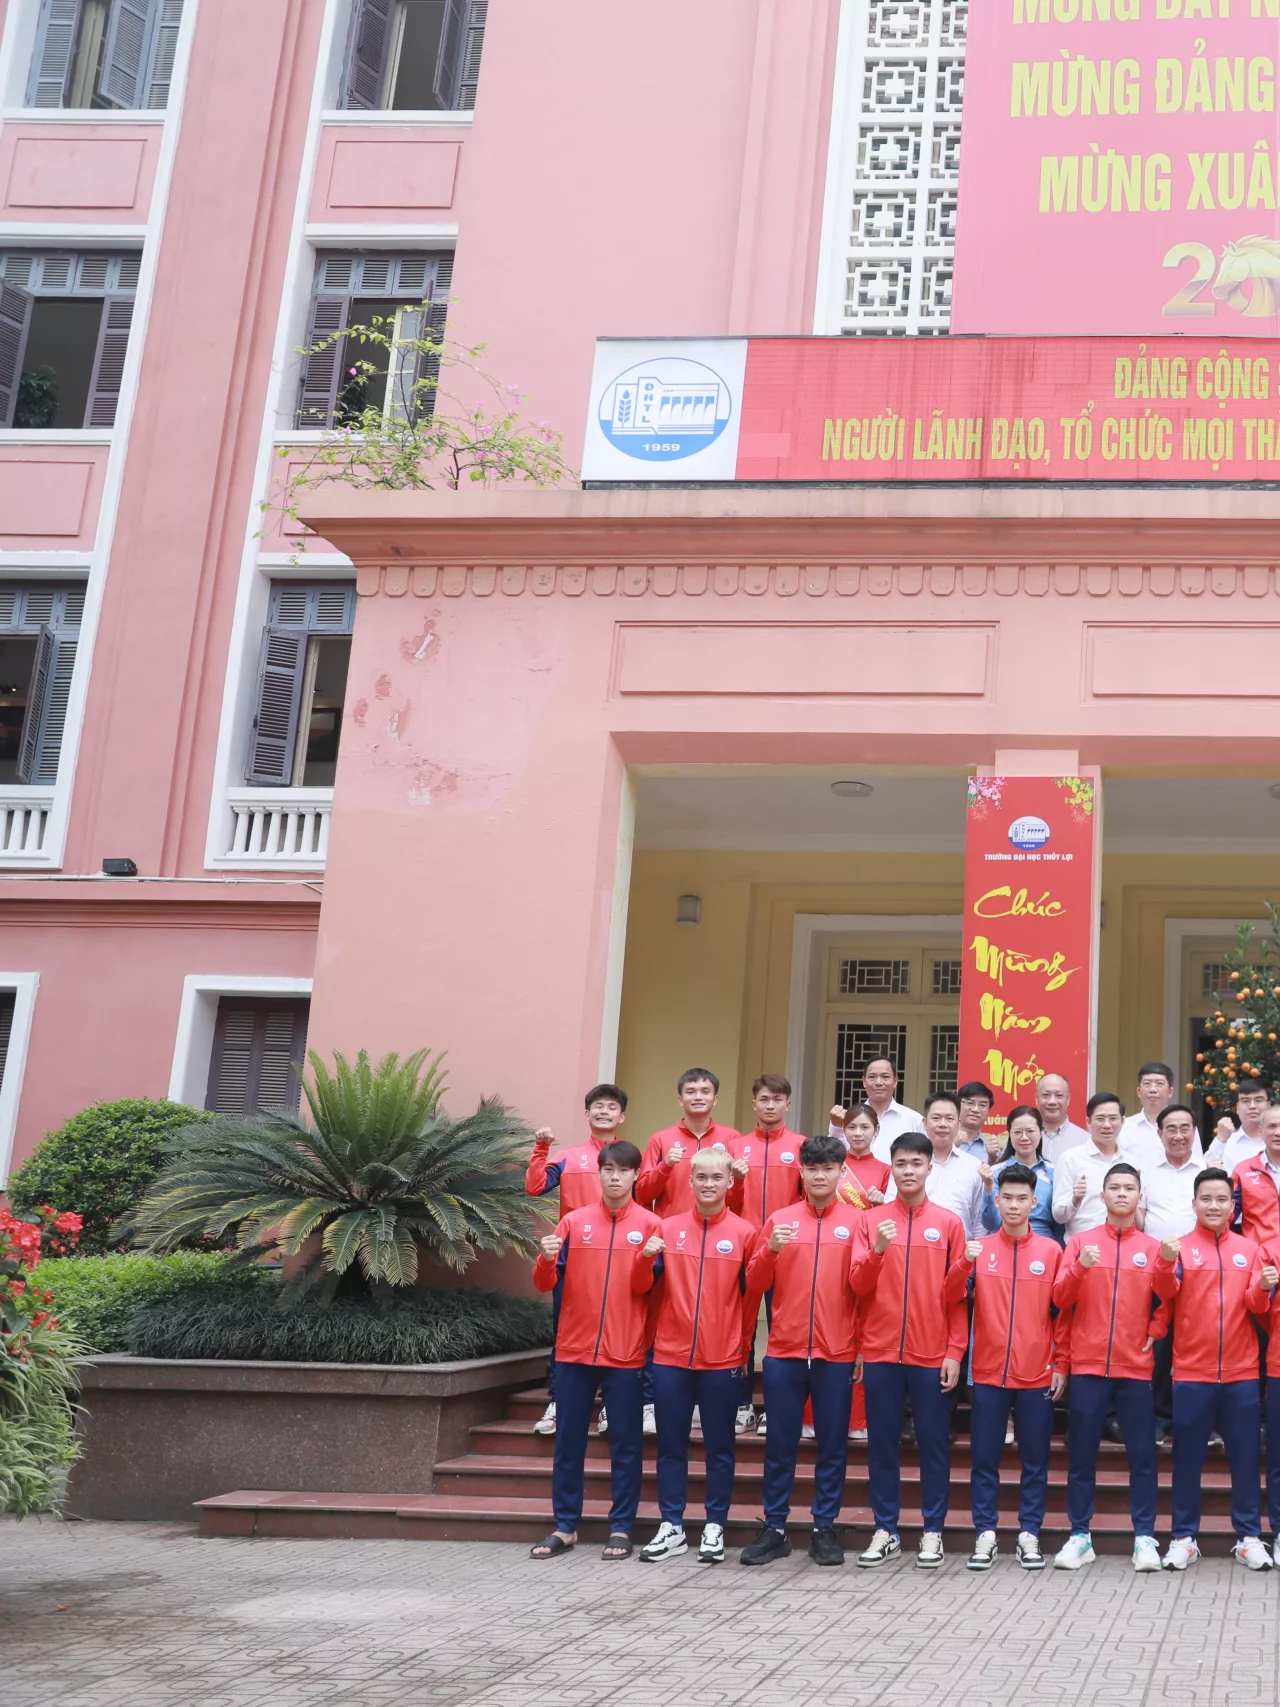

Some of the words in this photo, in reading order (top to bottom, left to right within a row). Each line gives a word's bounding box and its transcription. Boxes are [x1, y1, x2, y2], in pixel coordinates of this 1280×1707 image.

[1010, 48, 1141, 117] MỪNG
[1155, 37, 1275, 113] ĐẢNG
[1039, 142, 1172, 213] MỪNG
[1114, 343, 1188, 399] ĐẢNG
[1197, 349, 1269, 408] CỘNG
[642, 443, 681, 452] 1959
[822, 407, 905, 461] NGƯỜI
[912, 409, 983, 460] LÃNH
[991, 416, 1051, 470] ĐẠO,
[1060, 400, 1095, 460] TỔ
[1101, 408, 1173, 461] CHỨC
[1182, 418, 1234, 471] MỌI
[973, 886, 1066, 918] Chúc
[969, 935, 1082, 991] Mừng
[979, 992, 1052, 1040] Năm
[584, 1224, 592, 1232] 21
